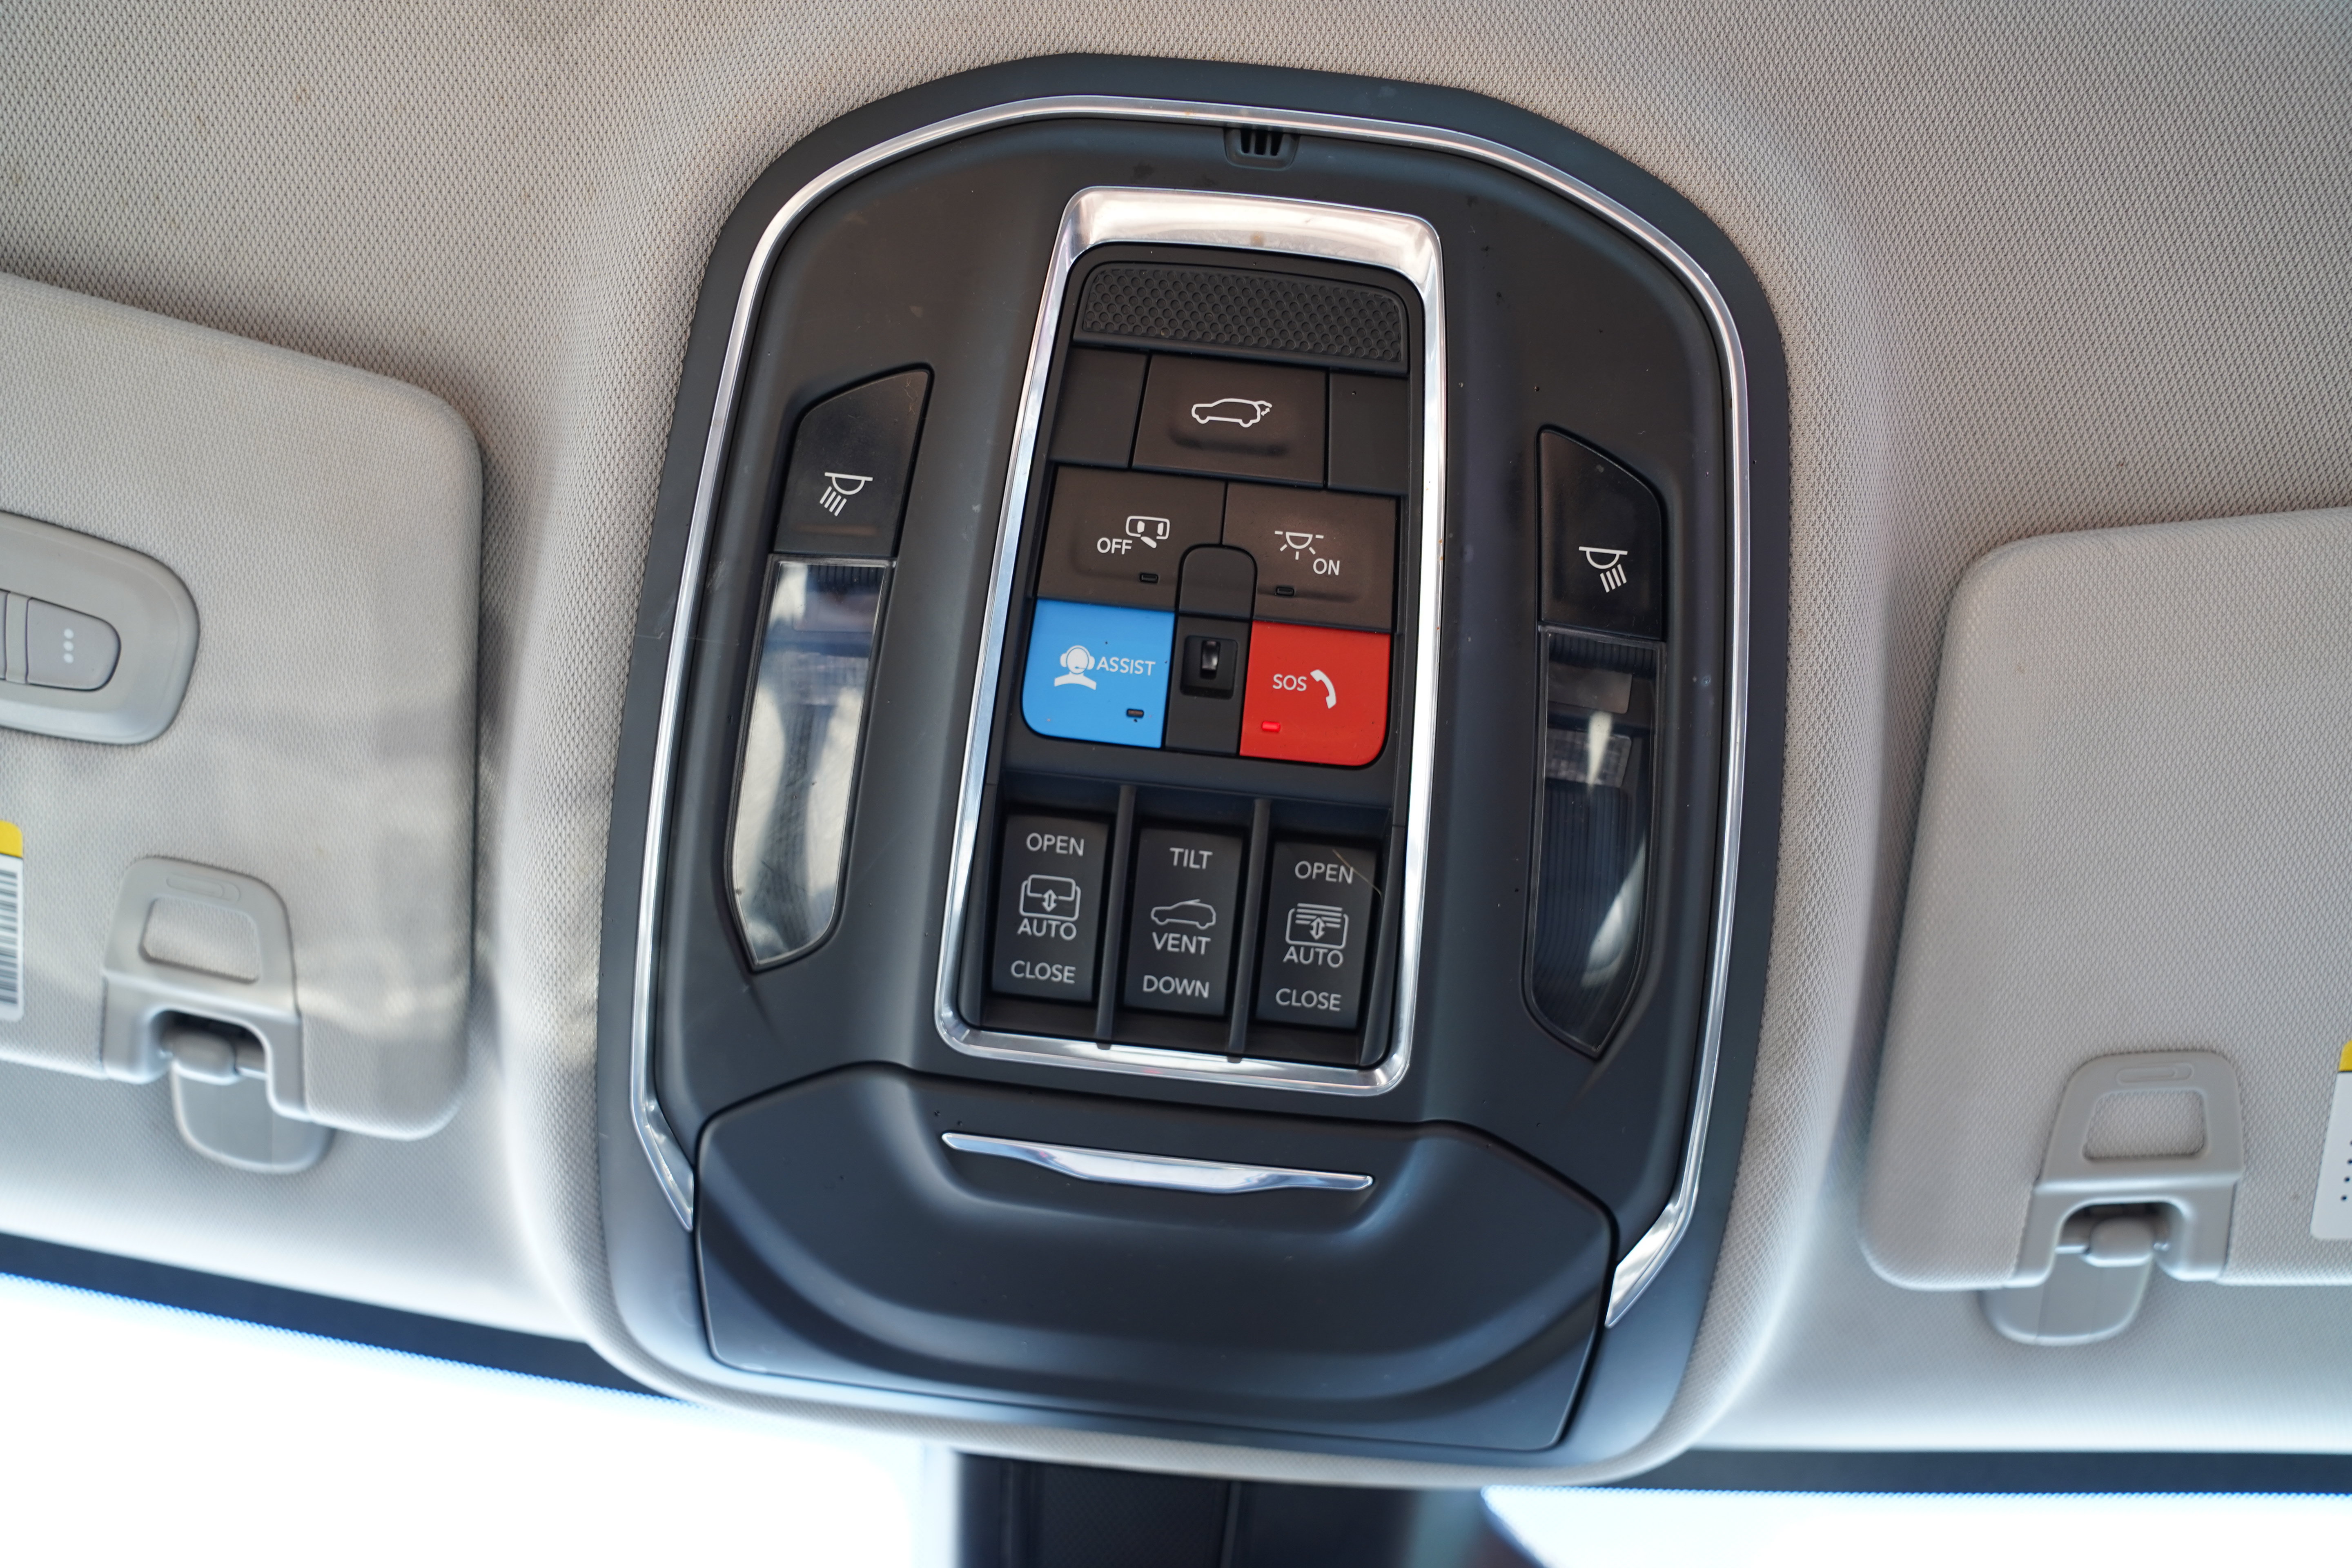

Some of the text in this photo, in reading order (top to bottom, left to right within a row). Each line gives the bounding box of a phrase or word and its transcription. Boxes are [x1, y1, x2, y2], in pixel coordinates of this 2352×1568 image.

[1096, 537, 1132, 555] OFF
[1312, 558, 1340, 576] ON
[1096, 657, 1156, 676] ASSIST
[1272, 674, 1307, 691] SOS
[1026, 832, 1085, 856] OPEN
[1169, 847, 1213, 869] TILT
[1294, 860, 1354, 884] OPEN
[1017, 919, 1077, 940] AUTO
[1152, 932, 1211, 955] VENT
[1282, 946, 1344, 968] AUTO
[1011, 960, 1076, 983] CLOSE
[1143, 975, 1209, 998] DOWN
[1275, 987, 1341, 1011] CLOSE
